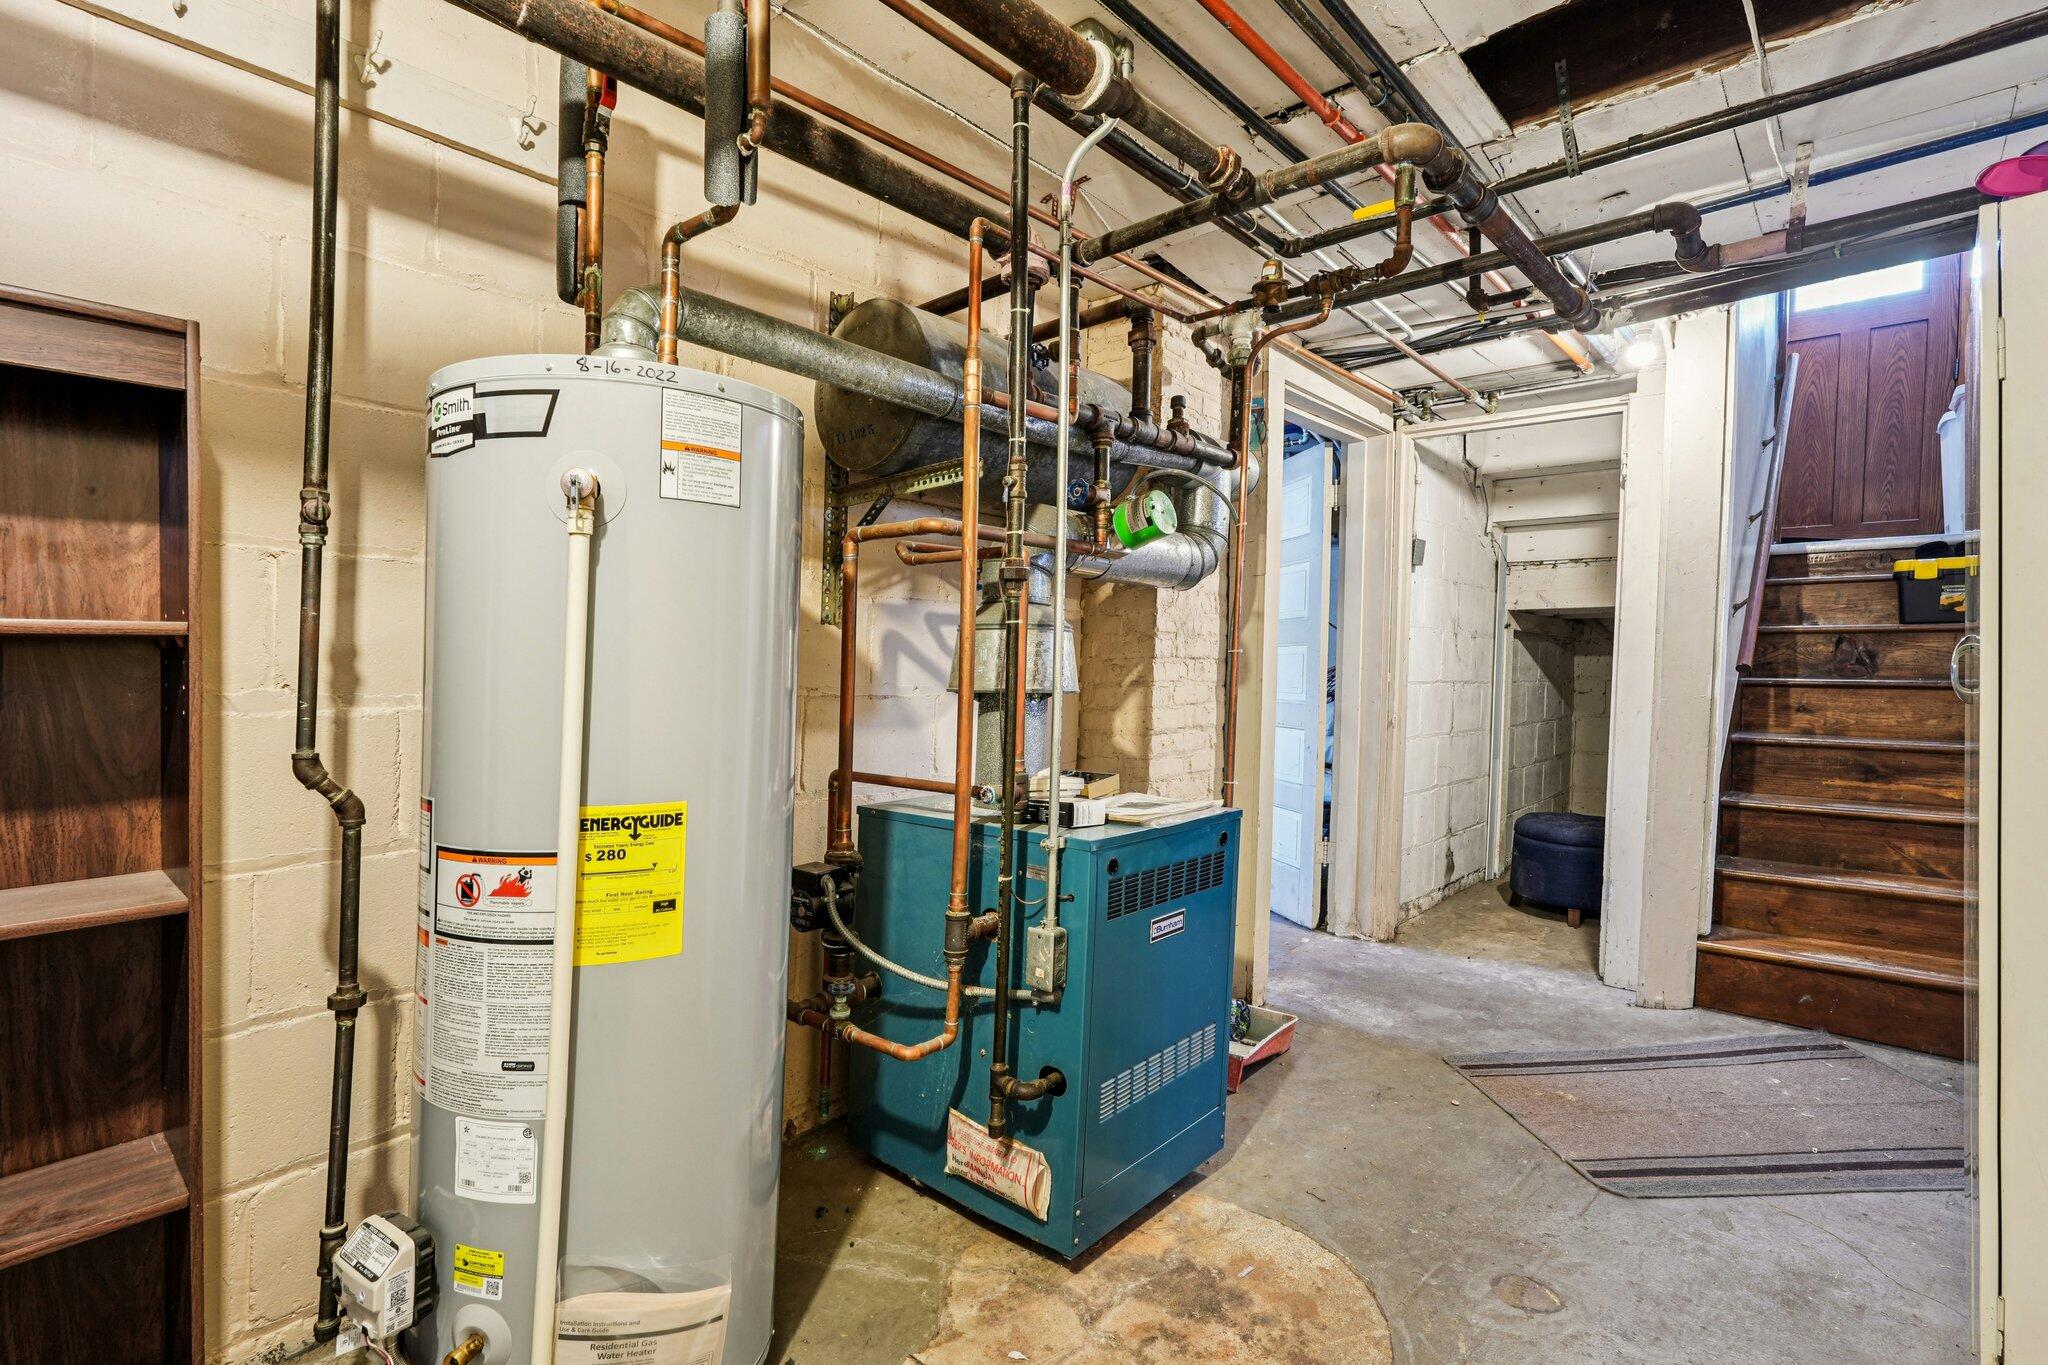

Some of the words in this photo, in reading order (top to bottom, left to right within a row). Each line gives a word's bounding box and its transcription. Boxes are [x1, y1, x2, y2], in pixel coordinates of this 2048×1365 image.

[576, 357, 679, 384] 8-16-2022
[436, 424, 461, 438] ProLine
[690, 447, 718, 456] WARNING
[580, 812, 684, 832] ENERGYGUIDE
[585, 853, 592, 862] $
[596, 849, 626, 861] 280
[1156, 919, 1182, 934] Burnham
[970, 1150, 1022, 1185] INFORMATION
[590, 1340, 639, 1351] Residential
[597, 1352, 624, 1360] Water
[627, 1349, 656, 1357] Heater
